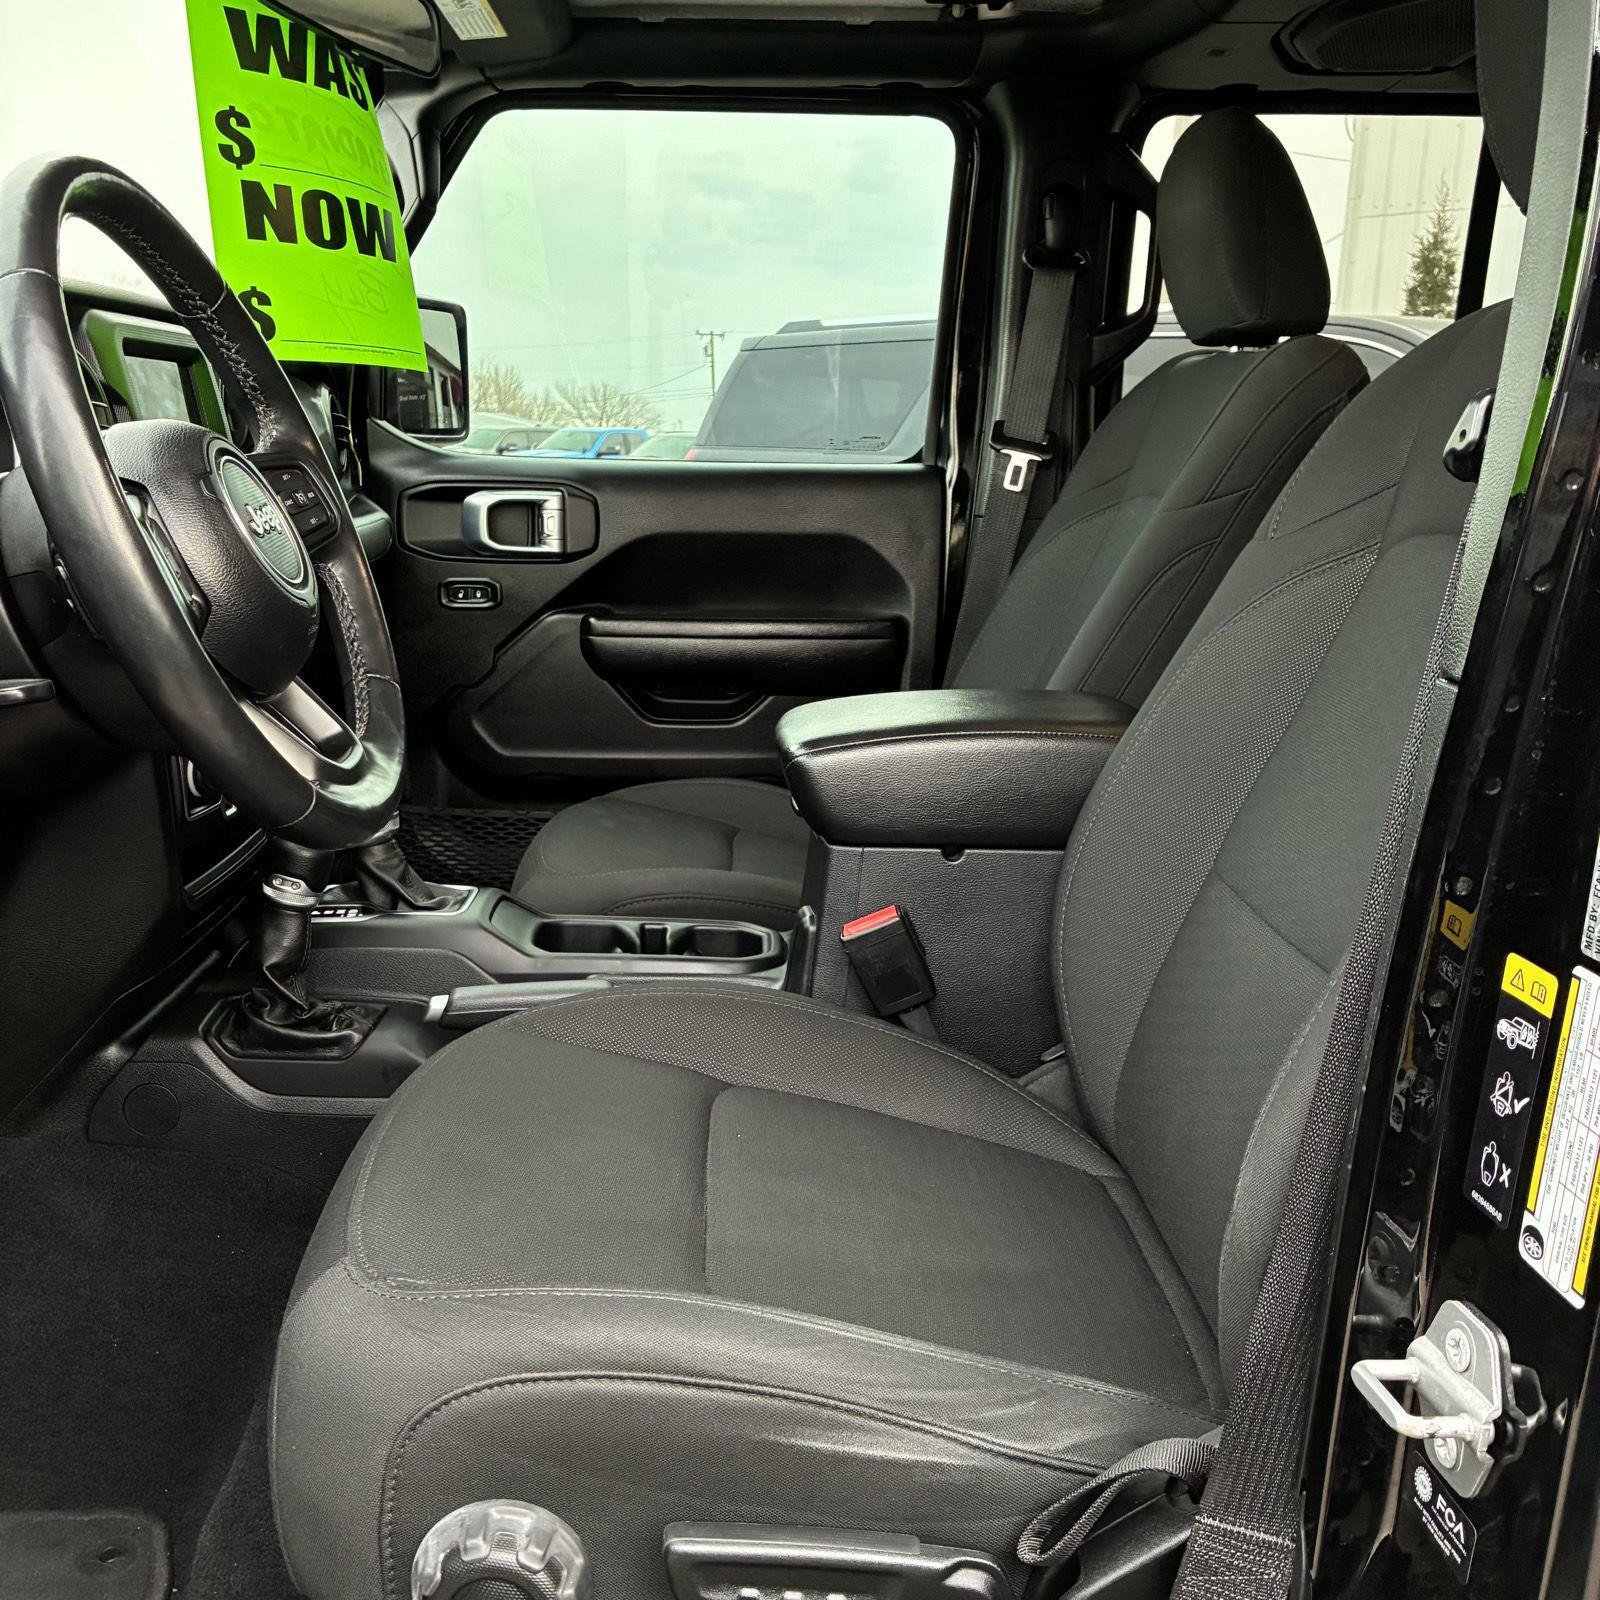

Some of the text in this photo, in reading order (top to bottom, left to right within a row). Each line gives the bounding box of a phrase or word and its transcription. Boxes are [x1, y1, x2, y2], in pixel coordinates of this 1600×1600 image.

[223, 5, 370, 112] WAS
[214, 105, 256, 171] $
[240, 179, 397, 263] NOW
[245, 503, 282, 537] Jeep
[1584, 925, 1595, 951] MFD
[1589, 903, 1600, 923] BY:
[1547, 1084, 1556, 1115] LOADING
[1553, 1036, 1566, 1084] INFORMATION
[1436, 1493, 1465, 1545] FCA
